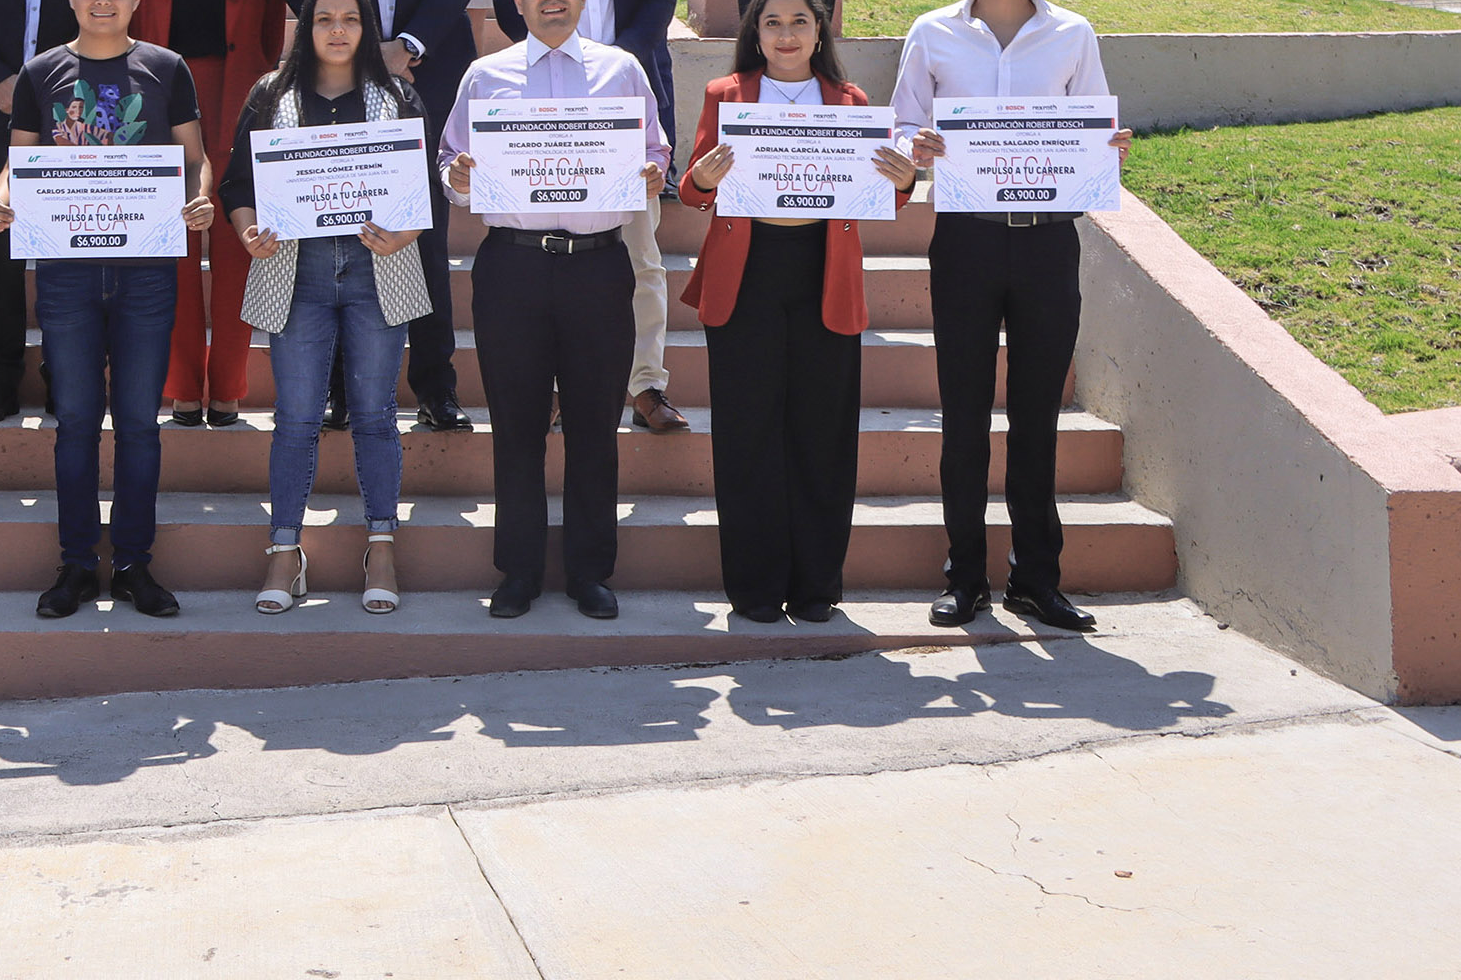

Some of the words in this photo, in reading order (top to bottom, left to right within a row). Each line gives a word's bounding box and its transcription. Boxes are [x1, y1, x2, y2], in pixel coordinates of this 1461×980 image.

[512, 122, 556, 130] FUNDACIÓN
[978, 120, 1023, 128] FUNDACIÓN
[761, 127, 804, 135] FUNDACIÓN
[836, 129, 862, 137] BOSCH
[1041, 138, 1080, 146] ENRÍQUEZ
[294, 148, 337, 158] FUNDACIÓN
[339, 146, 367, 155] ROBERT
[368, 144, 394, 152] BOSCH
[821, 146, 855, 154] ÁLVAREZ
[52, 169, 96, 177] FUNDACIÓN
[295, 167, 325, 175] JESSICA
[354, 162, 382, 170] FERMÍN
[511, 168, 546, 176] IMPULSO
[567, 167, 605, 175] CARRERA
[528, 157, 587, 186] BECA
[976, 166, 1013, 174] IMPULSO
[1015, 166, 1021, 174] A
[1023, 166, 1034, 174] TU
[1036, 166, 1075, 174] CARRERA
[995, 156, 1056, 184] BECA
[776, 162, 835, 192] BECA
[312, 179, 372, 211] BECA
[536, 190, 581, 201] $6,900.00
[1003, 189, 1049, 200] $6,900.00
[783, 195, 827, 207] $6,900.00
[51, 214, 86, 222] IMPULSO
[95, 213, 106, 221] TU
[107, 213, 144, 221] CARRERA
[68, 203, 127, 231] BECA
[322, 212, 366, 225] $6,900.00
[76, 235, 120, 246] $6,900.00
